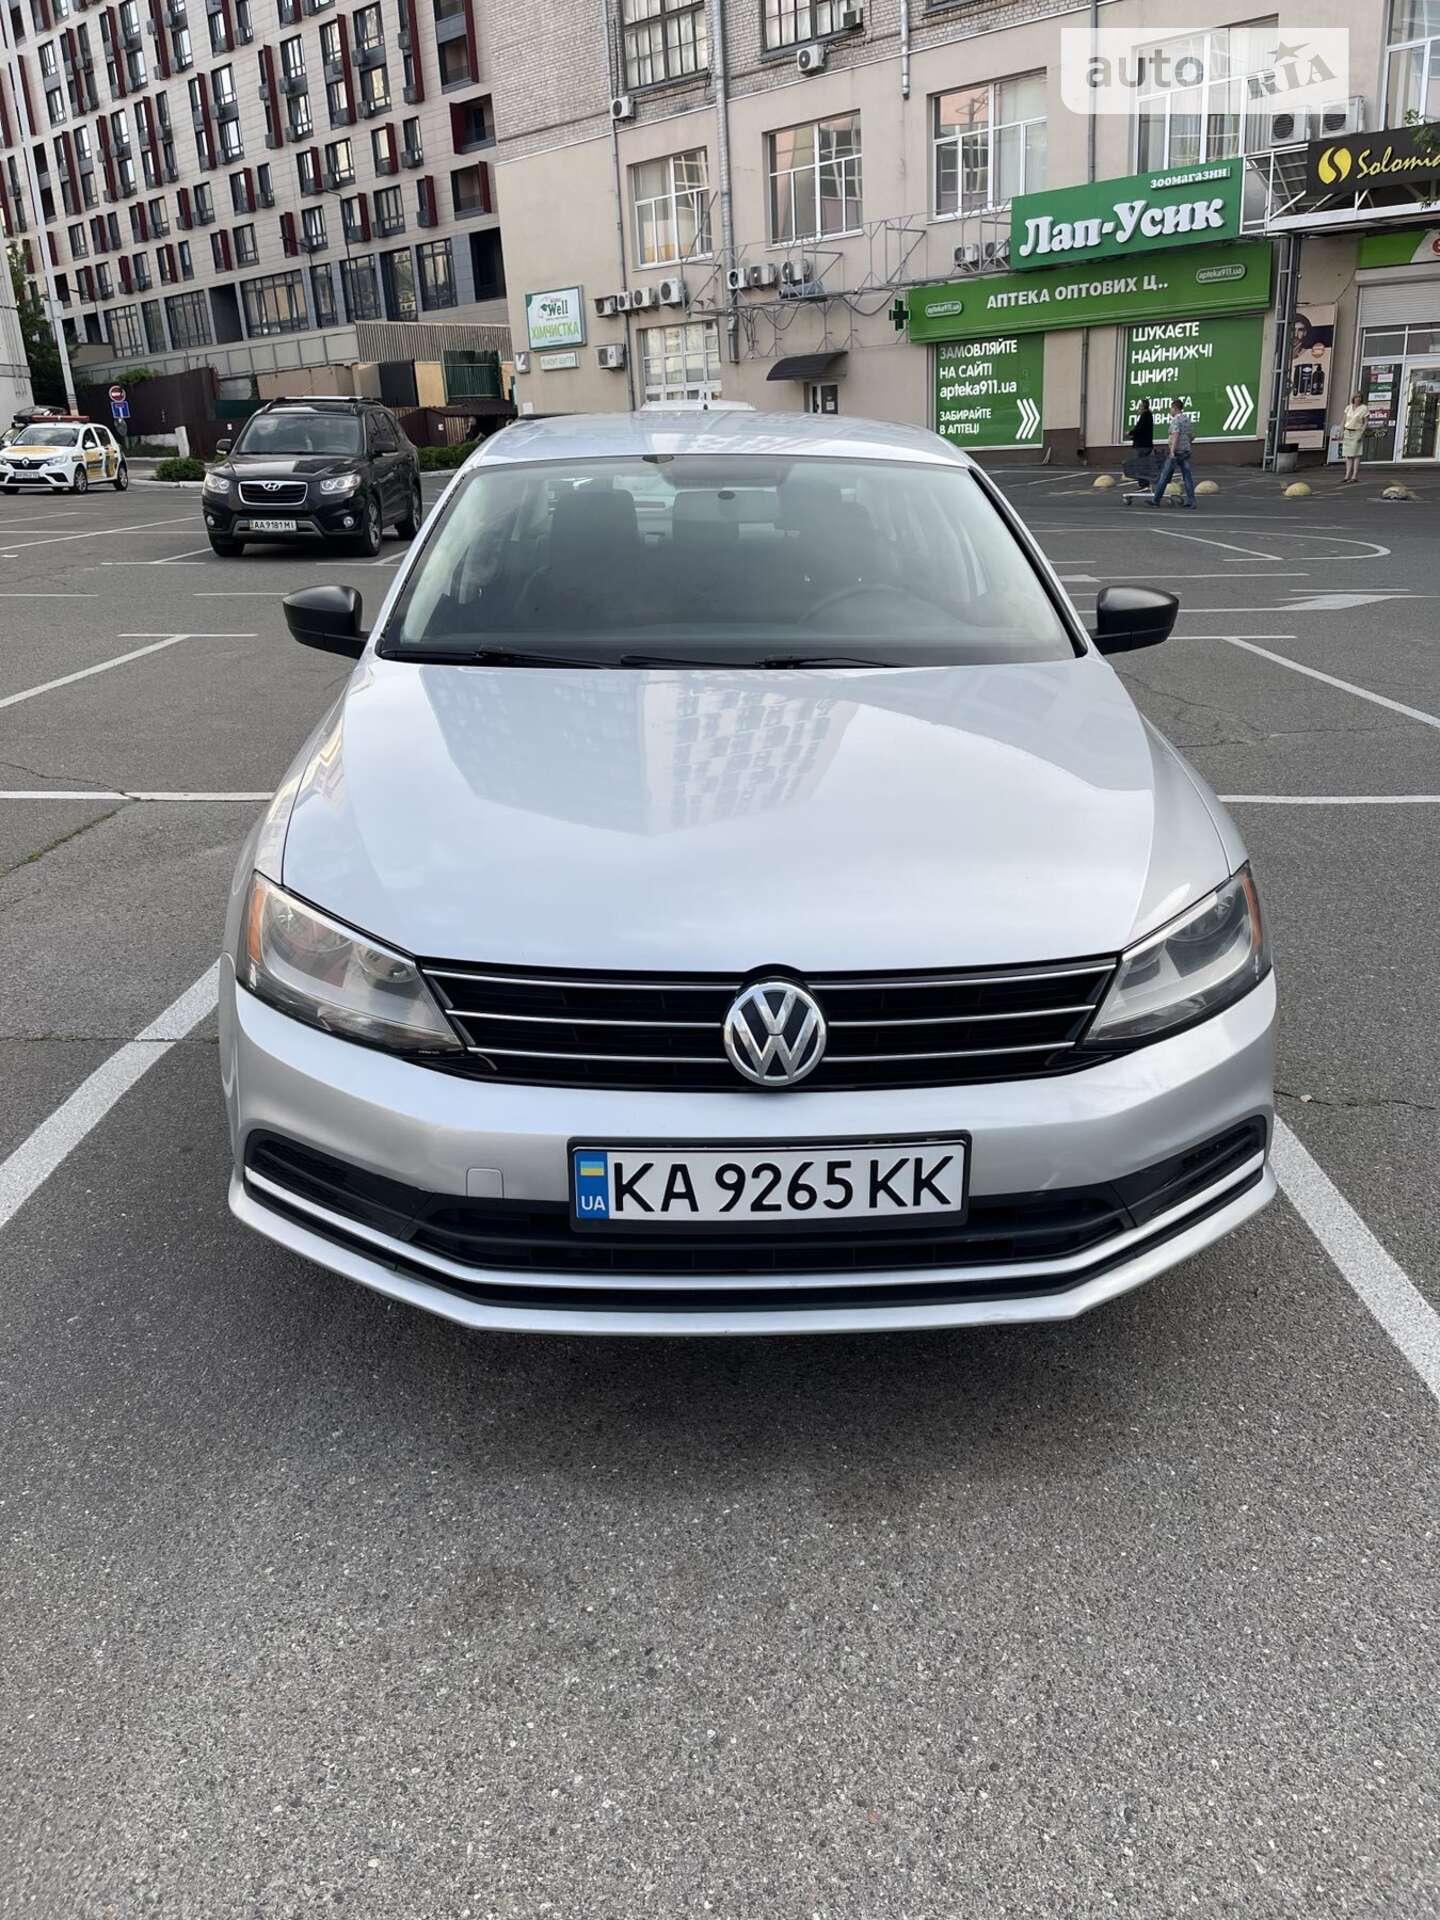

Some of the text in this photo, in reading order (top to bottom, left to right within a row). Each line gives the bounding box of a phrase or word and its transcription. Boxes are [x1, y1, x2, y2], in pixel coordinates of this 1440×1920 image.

[1150, 166, 1229, 190] зоомагазин
[1019, 198, 1225, 257] Лап-Усик
[986, 288, 1051, 309] АПТЕКА
[1054, 276, 1139, 301] ОПТОВИХ
[547, 299, 569, 317] Well
[1132, 321, 1200, 342] ШУКАЄТЕ
[940, 338, 1018, 360] ЗАМОВЛЯЙТЕ
[1131, 343, 1213, 364] НАЙНИЖЧІ
[940, 360, 993, 380] НА САЙТІ
[1130, 367, 1179, 387] ЦІНИ?!
[940, 379, 1018, 401] apteka911.ua
[939, 406, 992, 421] ЗАБИРАЙТЕ
[1128, 411, 1201, 427] ПІВНТЕ!
[939, 422, 980, 435] В АПТЕЦІ
[614, 1155, 955, 1213] KA 9265 KK
[581, 1195, 606, 1211] UA
